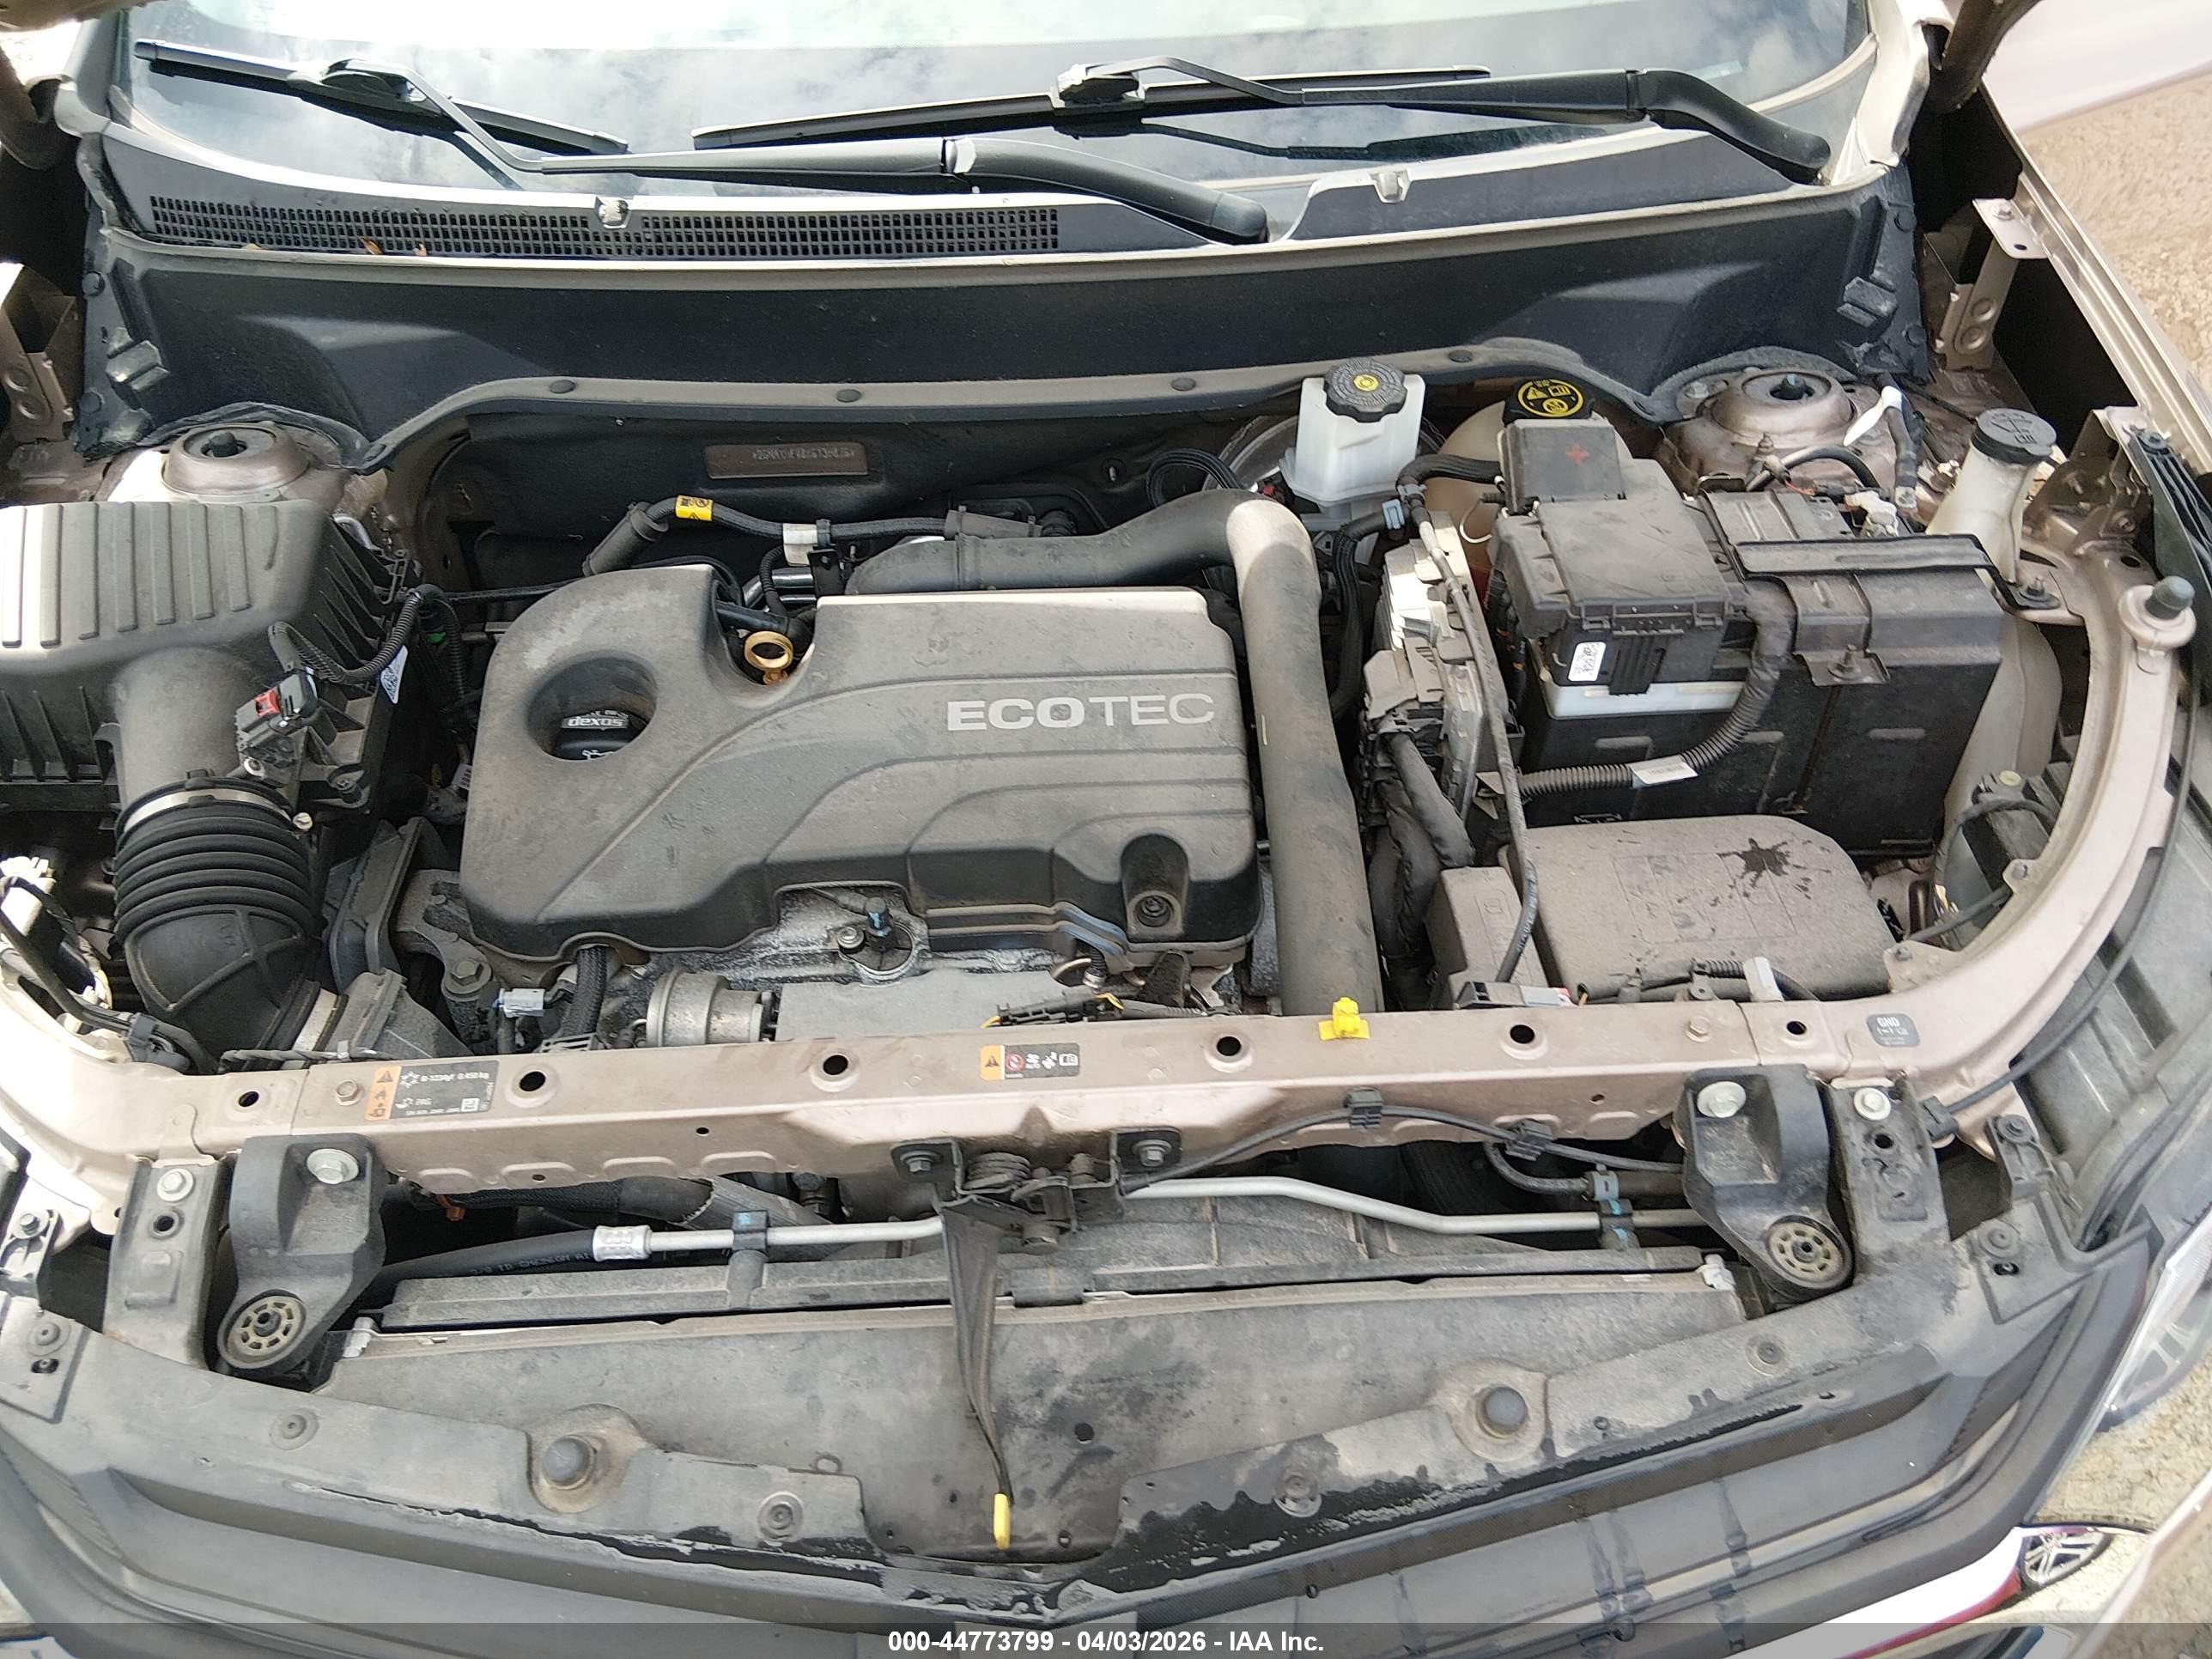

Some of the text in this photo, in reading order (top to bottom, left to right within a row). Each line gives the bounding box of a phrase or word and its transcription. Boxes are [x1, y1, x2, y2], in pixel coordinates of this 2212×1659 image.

[947, 693, 1215, 731] ECOTEC
[568, 716, 624, 727] dexos
[1876, 1017, 1900, 1027] GND
